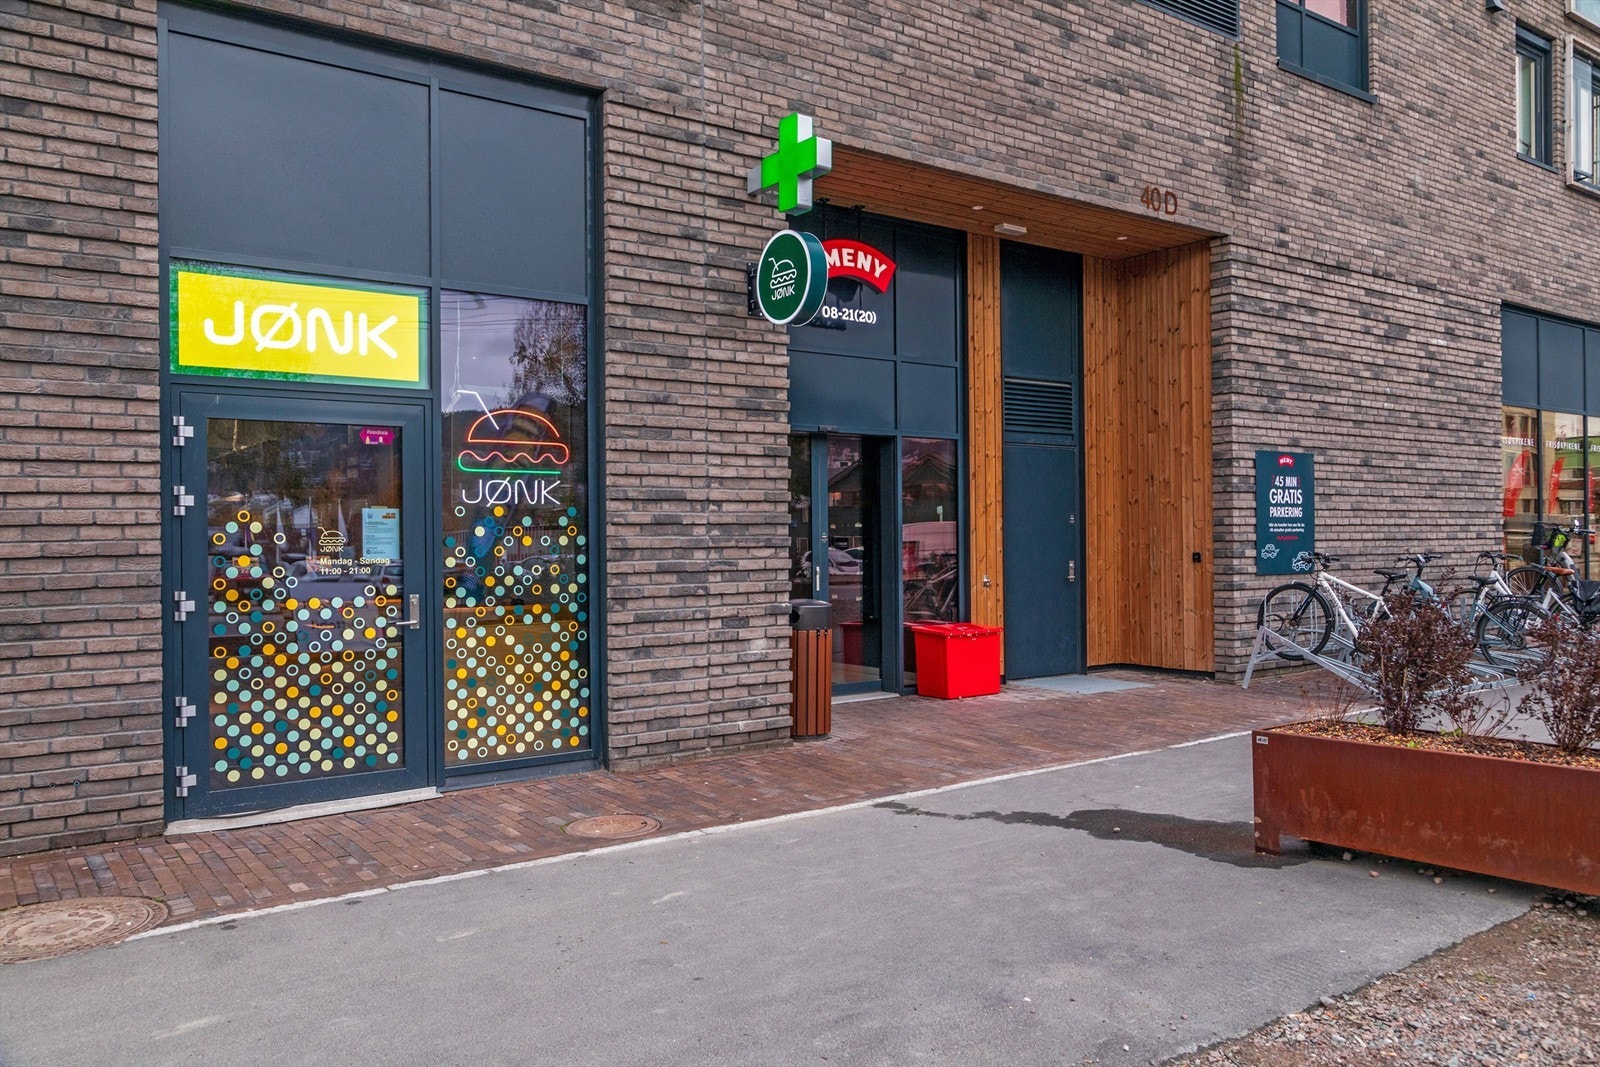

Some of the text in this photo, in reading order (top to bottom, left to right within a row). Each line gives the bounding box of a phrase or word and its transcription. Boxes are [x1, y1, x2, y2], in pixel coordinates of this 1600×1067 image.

[1140, 185, 1178, 216] 40 D
[827, 248, 888, 279] MENY
[771, 284, 796, 301] JØNK
[821, 305, 877, 325] 08-21(20)
[203, 300, 399, 360] JØNK
[1274, 475, 1298, 487] 45 MIN
[461, 476, 562, 508] JØNK
[1269, 488, 1303, 505] GRATIS
[1269, 506, 1303, 518] PARKERING
[320, 557, 353, 566] Mandag
[321, 567, 342, 575] 11:00
[348, 567, 371, 575] 21:00
